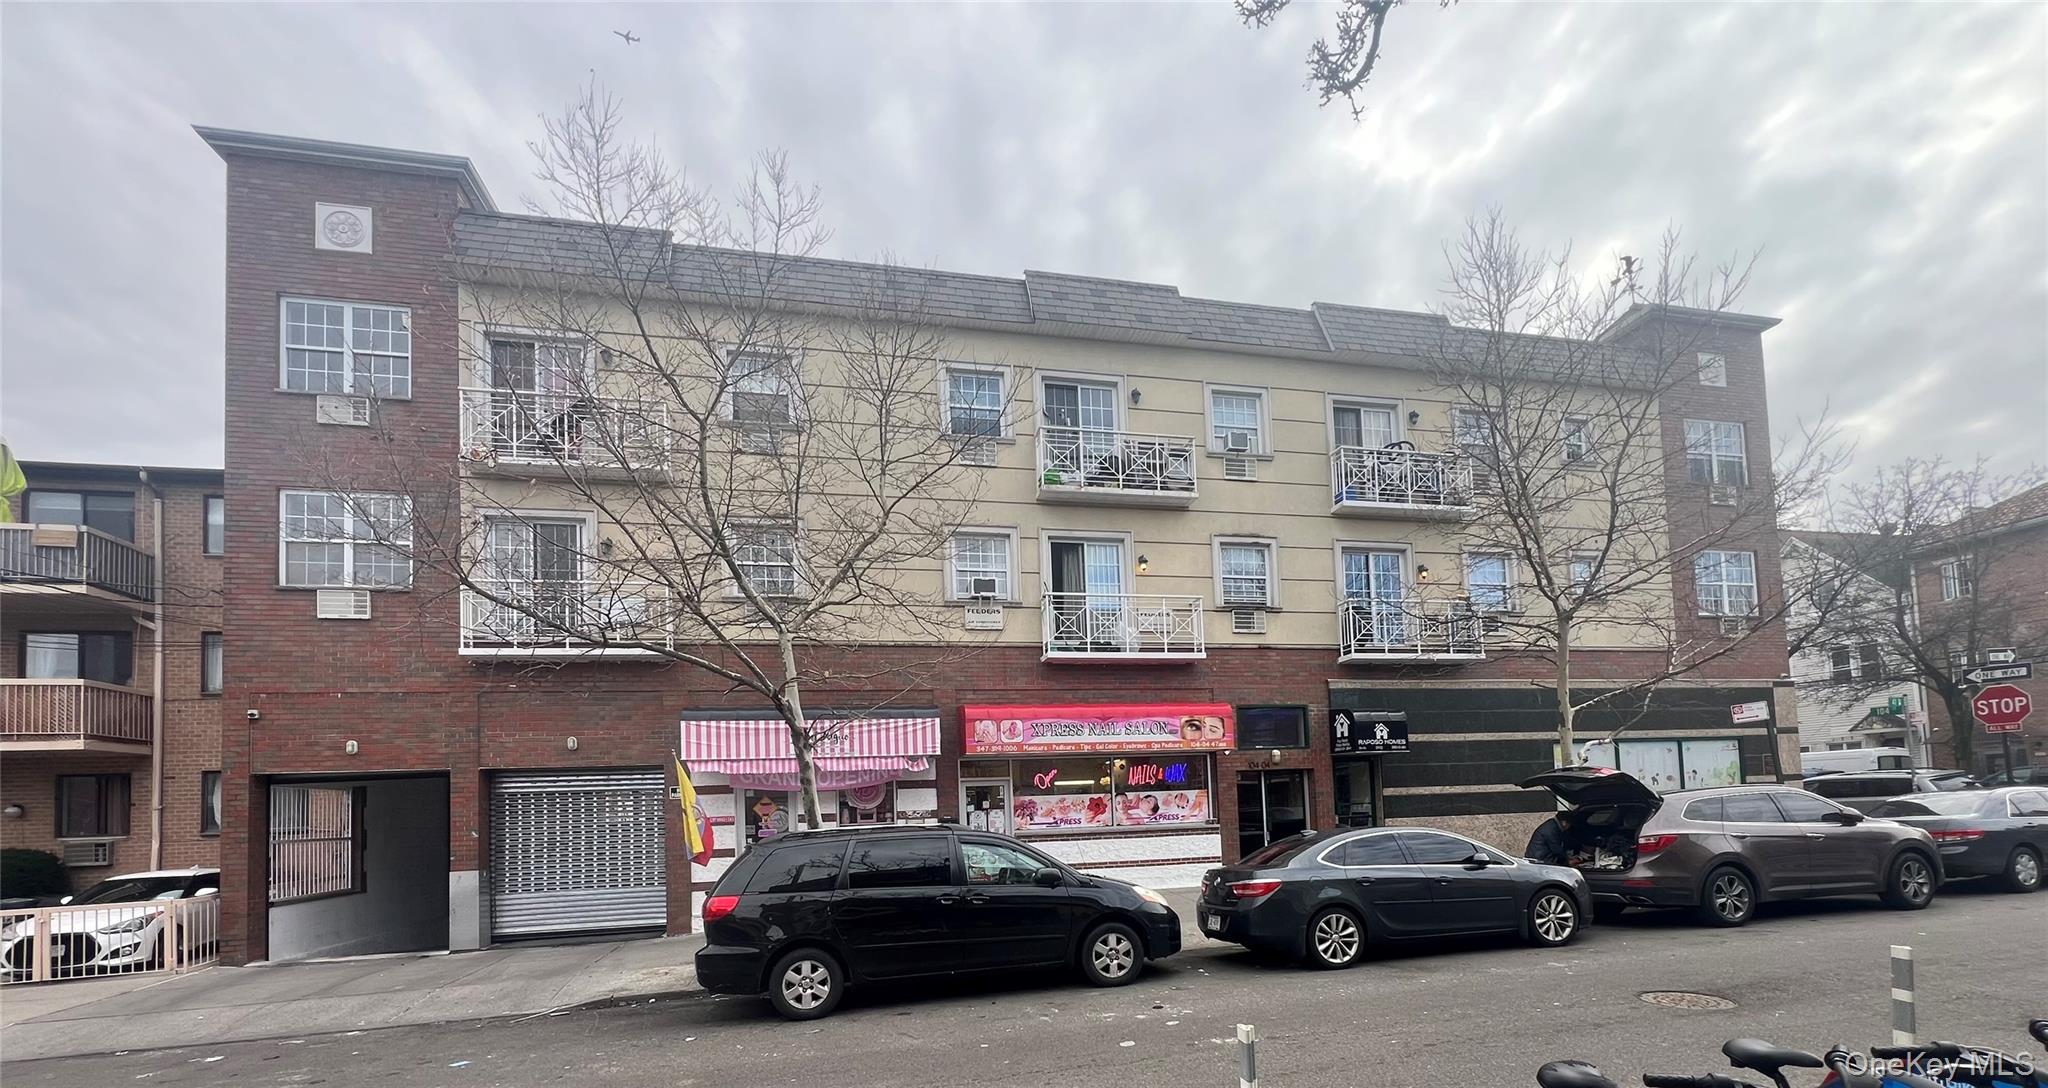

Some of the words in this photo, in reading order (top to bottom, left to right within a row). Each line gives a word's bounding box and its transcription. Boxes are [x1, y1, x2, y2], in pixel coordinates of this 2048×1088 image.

[2000, 669, 2022, 677] WAY
[1977, 697, 2027, 716] STOP
[1030, 721, 1085, 738] XPRESS
[1087, 721, 1122, 737] NAIL
[1124, 720, 1169, 736] SALON
[739, 773, 801, 786] GRAN
[1128, 763, 1157, 787] NAILS
[1164, 762, 1188, 784] WAX
